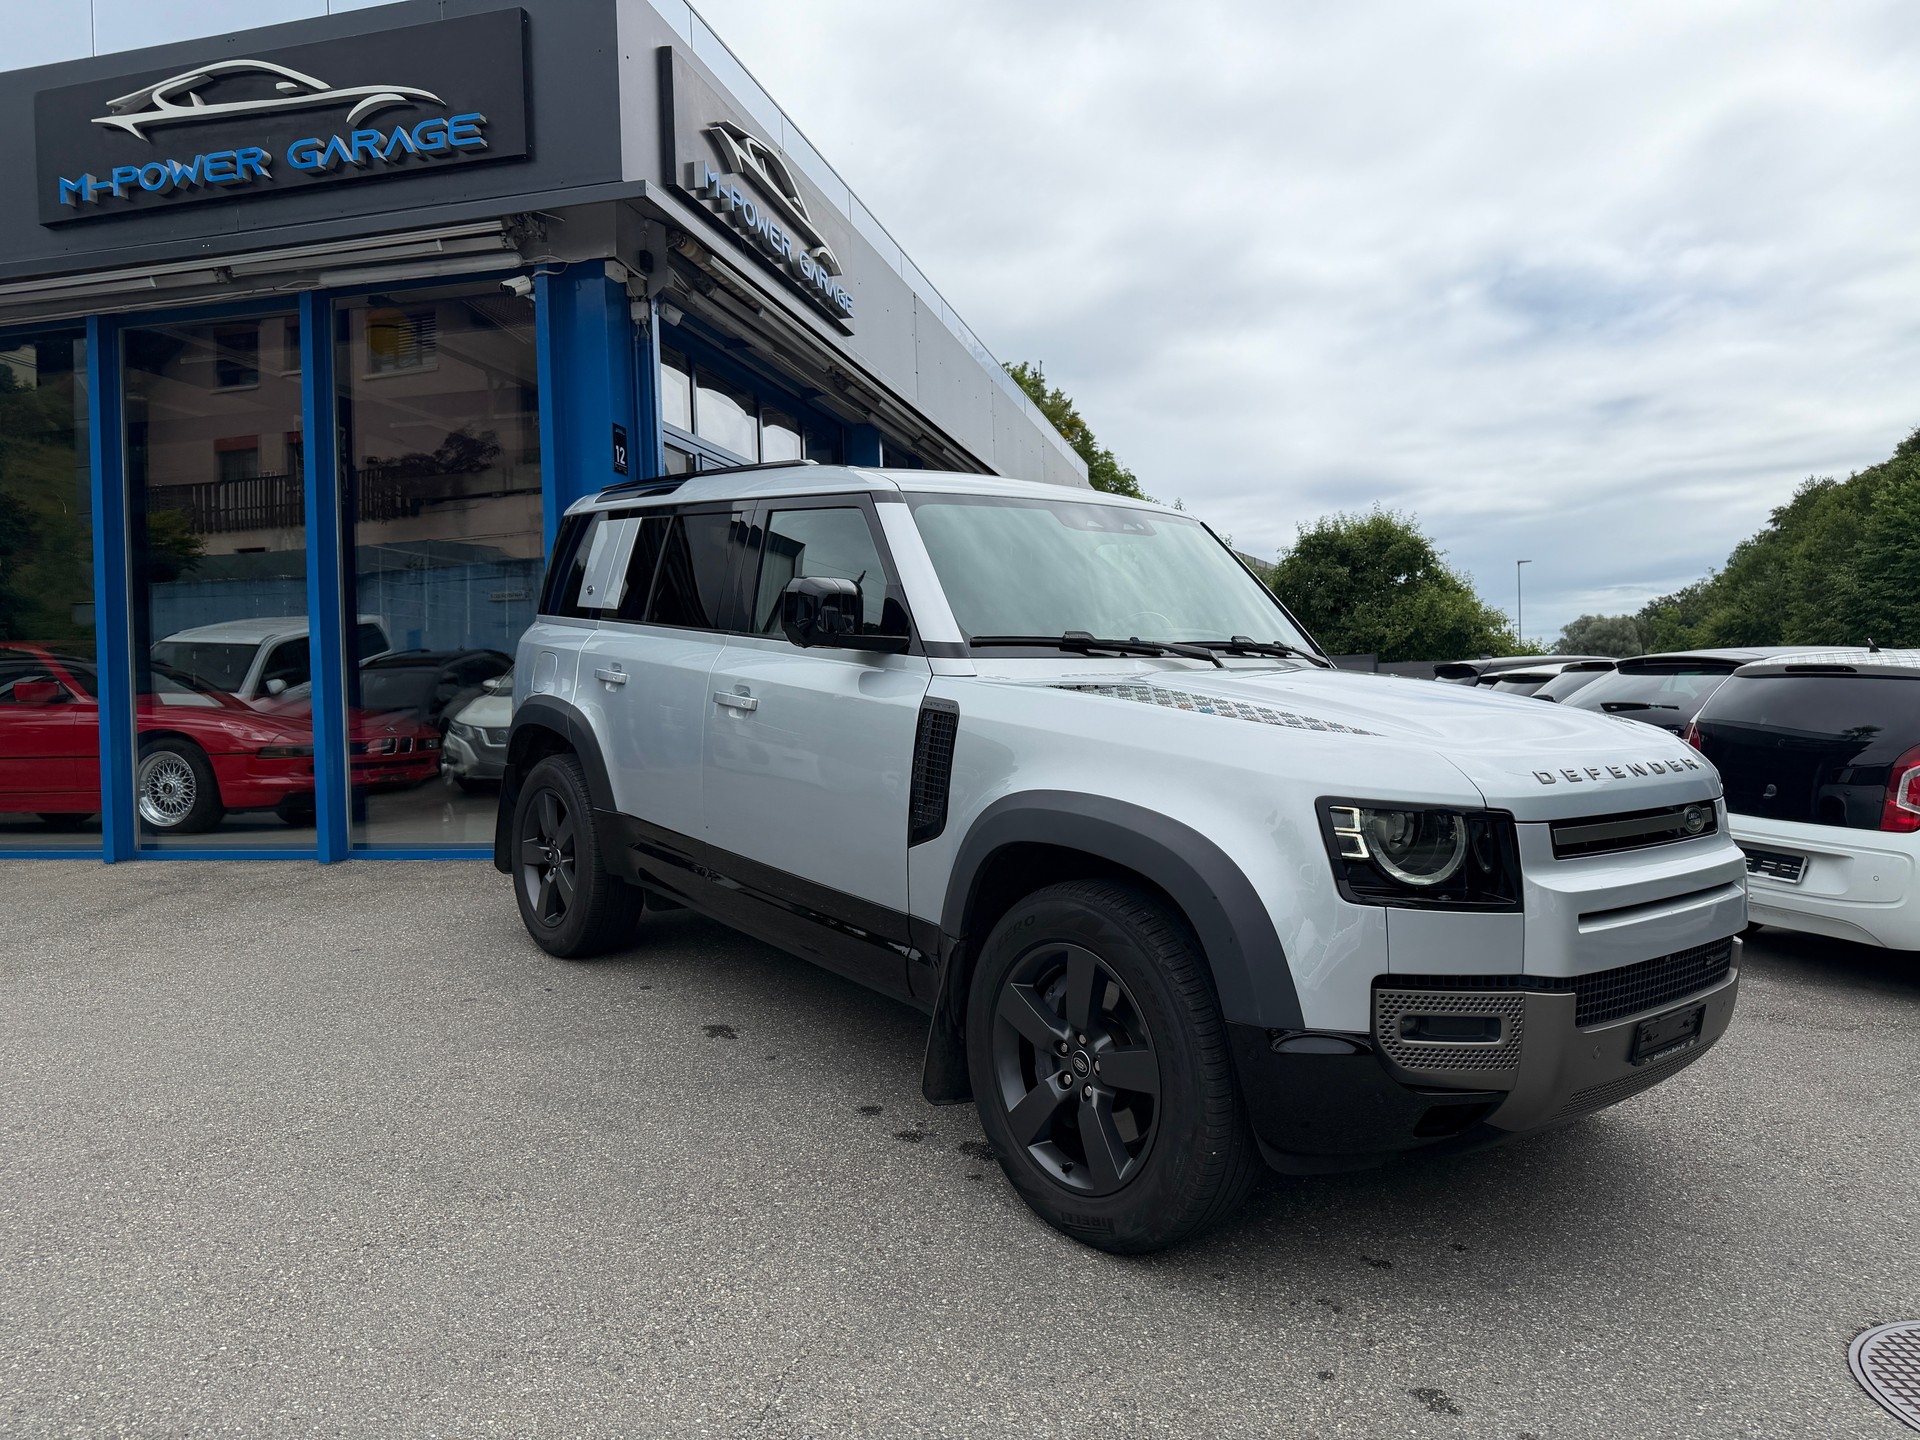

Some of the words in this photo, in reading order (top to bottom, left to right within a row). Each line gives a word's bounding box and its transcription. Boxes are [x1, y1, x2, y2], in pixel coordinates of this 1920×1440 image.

[59, 146, 268, 206] M-POWER
[287, 112, 484, 171] GARAGE
[703, 160, 794, 263] M-POWER
[798, 250, 855, 318] GARAGE
[615, 444, 626, 465] 12
[1532, 757, 1700, 785] DEFENDER
